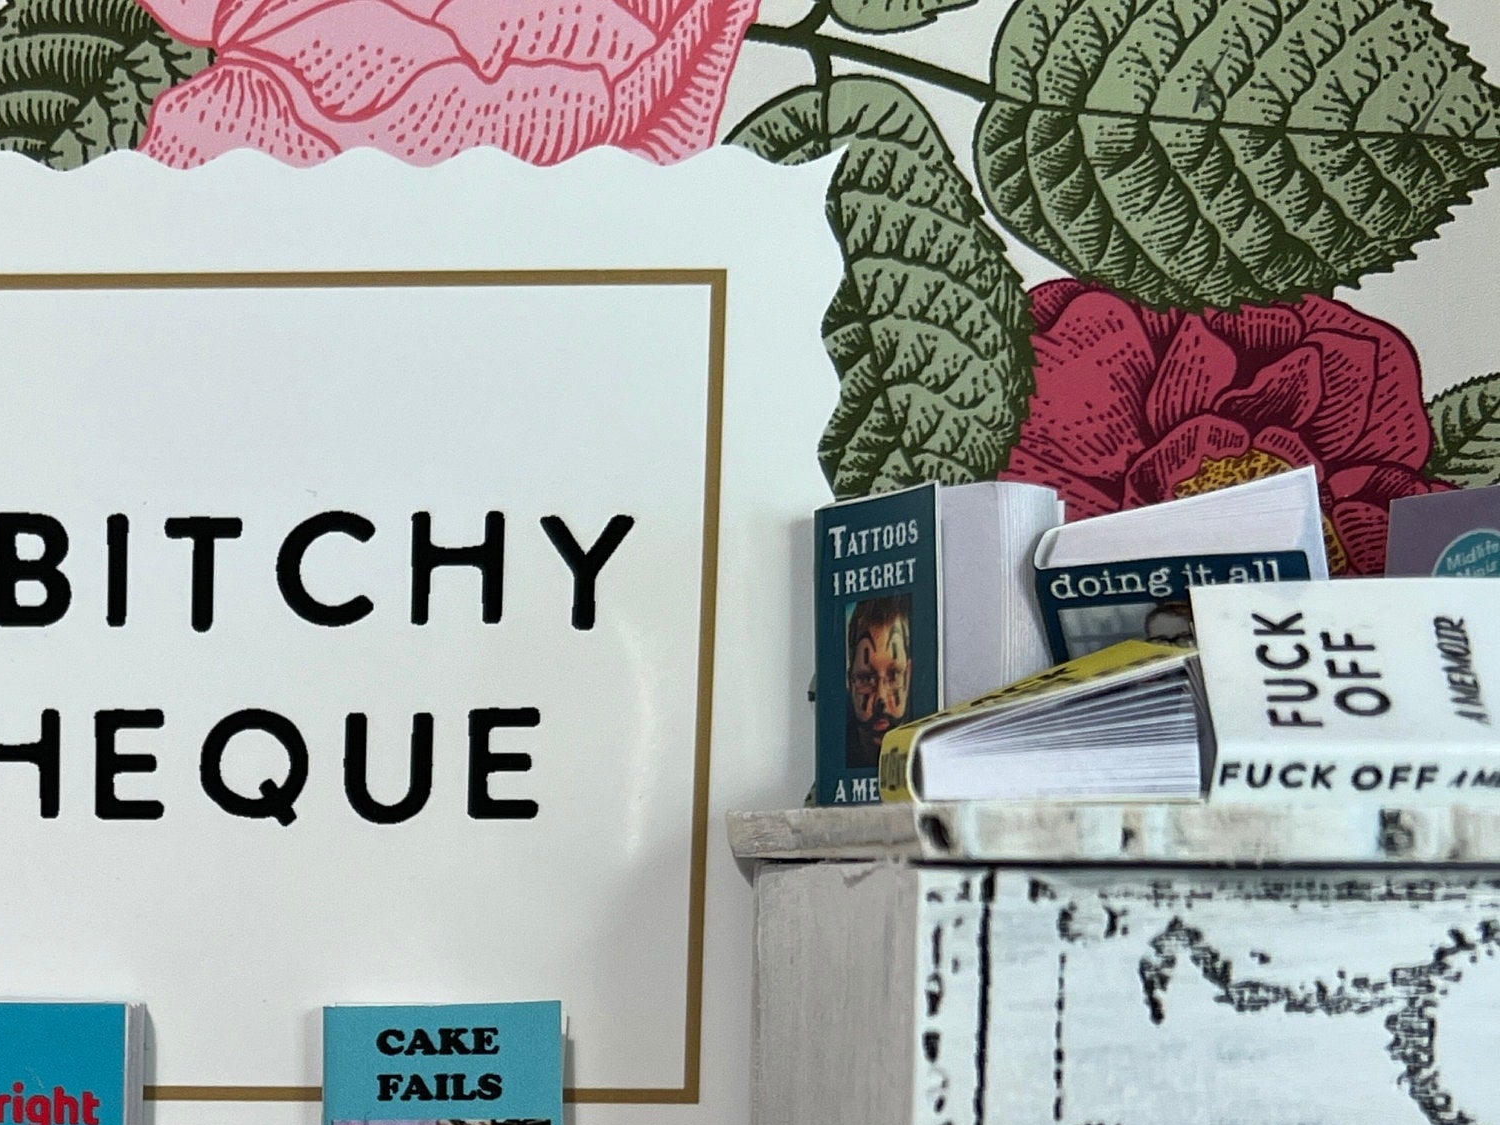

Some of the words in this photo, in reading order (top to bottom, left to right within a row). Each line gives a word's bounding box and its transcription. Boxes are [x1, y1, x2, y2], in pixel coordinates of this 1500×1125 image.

[833, 572, 840, 596] I
[845, 558, 916, 594] REGRET
[1050, 566, 1172, 600] doing
[1181, 563, 1216, 588] it
[1229, 560, 1279, 583] all
[1251, 612, 1323, 727] FUCK
[1320, 631, 1391, 717] OFF
[1433, 615, 1485, 707] MEMOIR
[834, 779, 847, 802] A
[1219, 762, 1336, 790] FUCK
[1351, 764, 1439, 791] OFF
[376, 1027, 499, 1056] CAKE
[376, 1072, 503, 1102] FAILS
